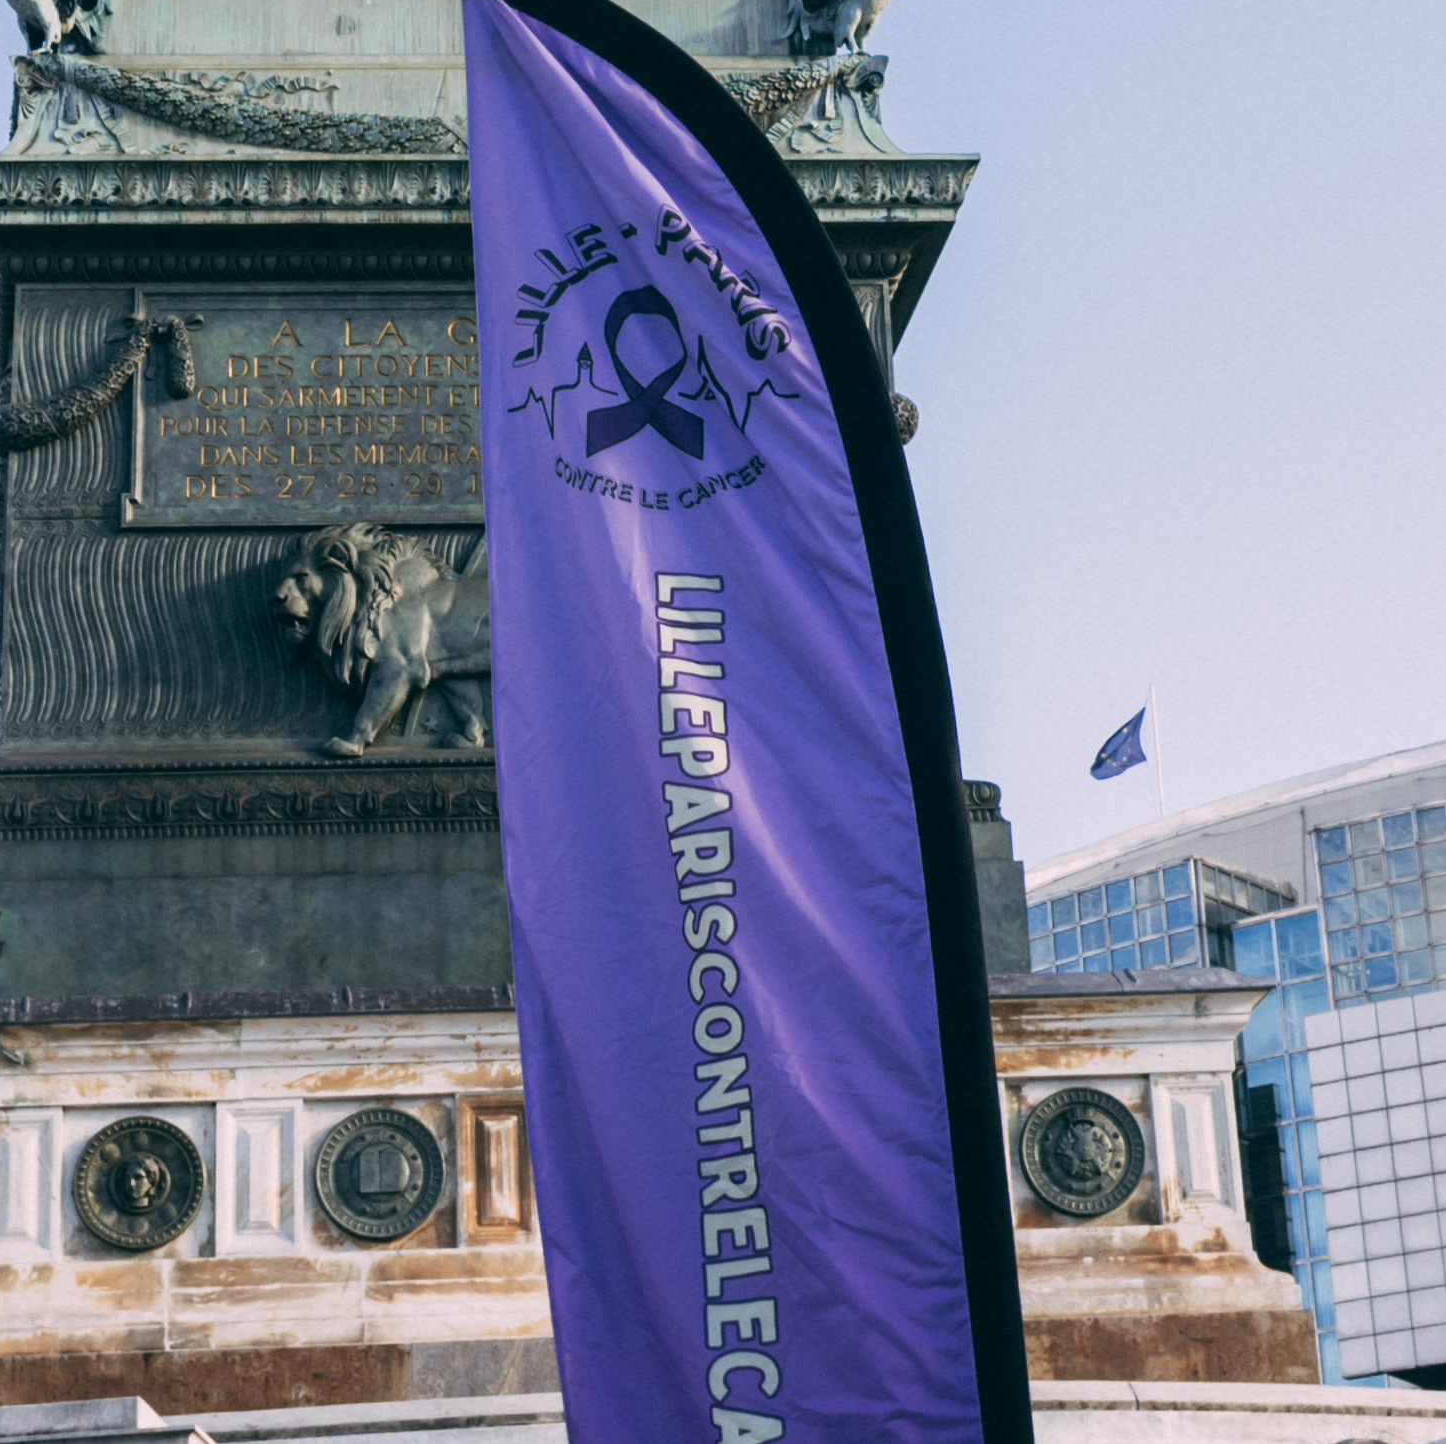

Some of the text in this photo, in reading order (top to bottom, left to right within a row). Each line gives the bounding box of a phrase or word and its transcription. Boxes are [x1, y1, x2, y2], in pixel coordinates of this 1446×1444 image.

[345, 318, 407, 347] LA
[448, 316, 477, 346] G
[228, 355, 294, 379] DES
[197, 386, 248, 411] QUI
[449, 384, 479, 406] ET
[160, 416, 230, 437] POUR
[241, 416, 275, 437] LA
[421, 414, 472, 435] DES
[201, 437, 481, 467] DANS LES MÉMORA
[185, 474, 253, 499] DES
[555, 455, 766, 511] CONTRE LE CANCER
